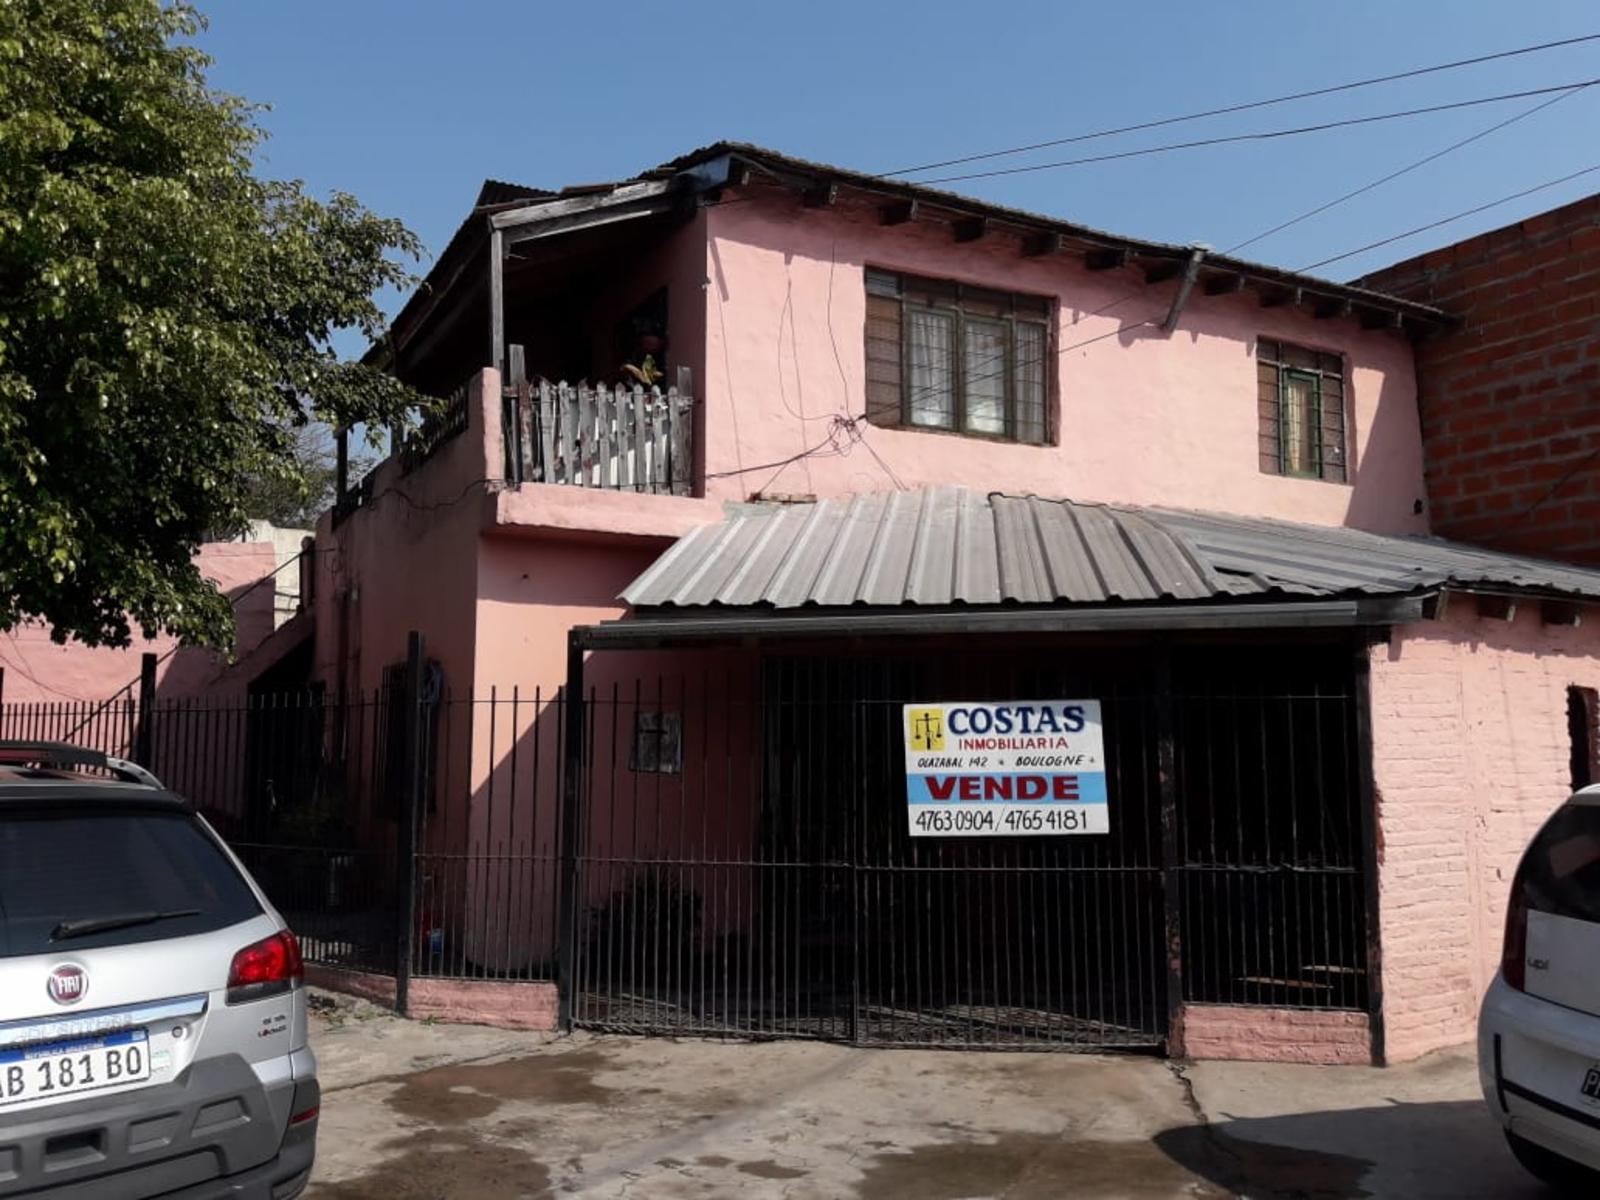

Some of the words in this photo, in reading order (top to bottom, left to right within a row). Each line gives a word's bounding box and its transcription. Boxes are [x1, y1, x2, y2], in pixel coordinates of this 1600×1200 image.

[948, 706, 1085, 735] COSTAS
[959, 737, 1069, 750] INMOBILIARIA
[969, 757, 988, 768] 142
[1015, 755, 1086, 767] BOULOGNE
[925, 775, 1080, 801] VENDE
[57, 974, 81, 995] FIAT
[38, 1054, 94, 1092] 181
